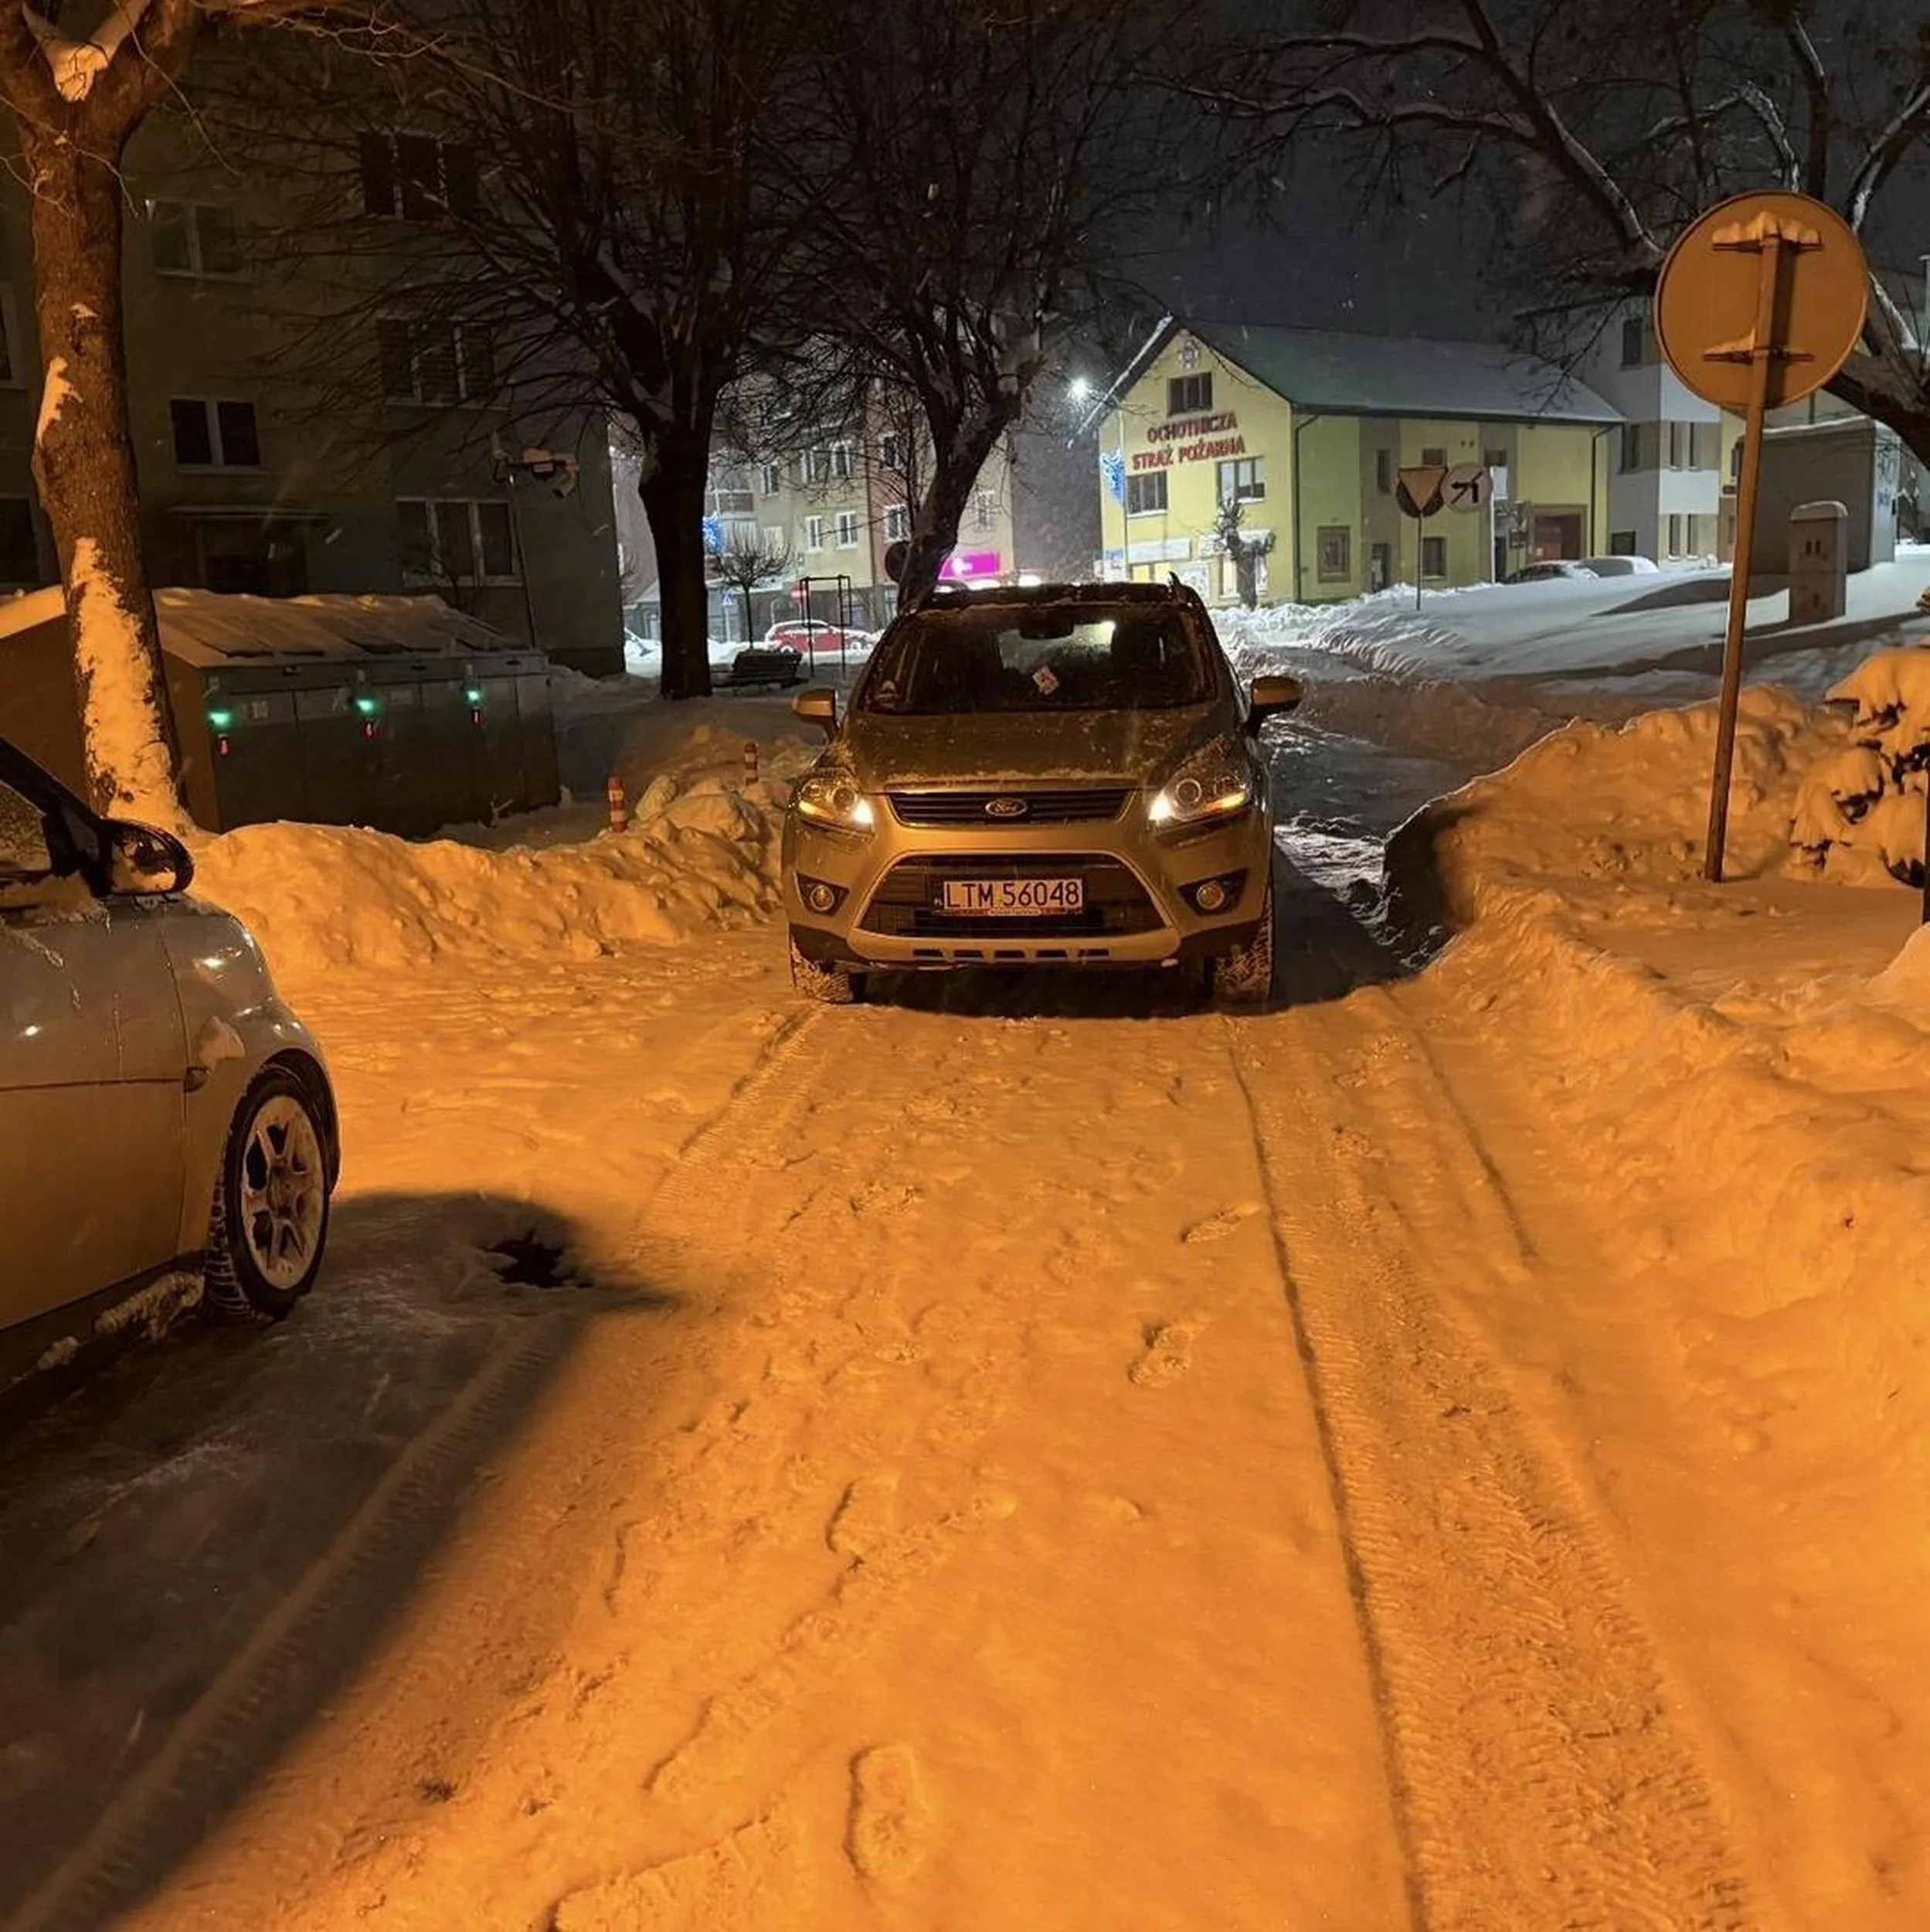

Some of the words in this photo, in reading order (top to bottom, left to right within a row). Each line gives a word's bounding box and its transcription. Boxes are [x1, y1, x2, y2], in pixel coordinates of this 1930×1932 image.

[1147, 411, 1238, 443] OCHOTNICZA
[1179, 434, 1245, 462] POŻARNA
[946, 883, 994, 907] LTM
[1003, 881, 1079, 906] 56048
